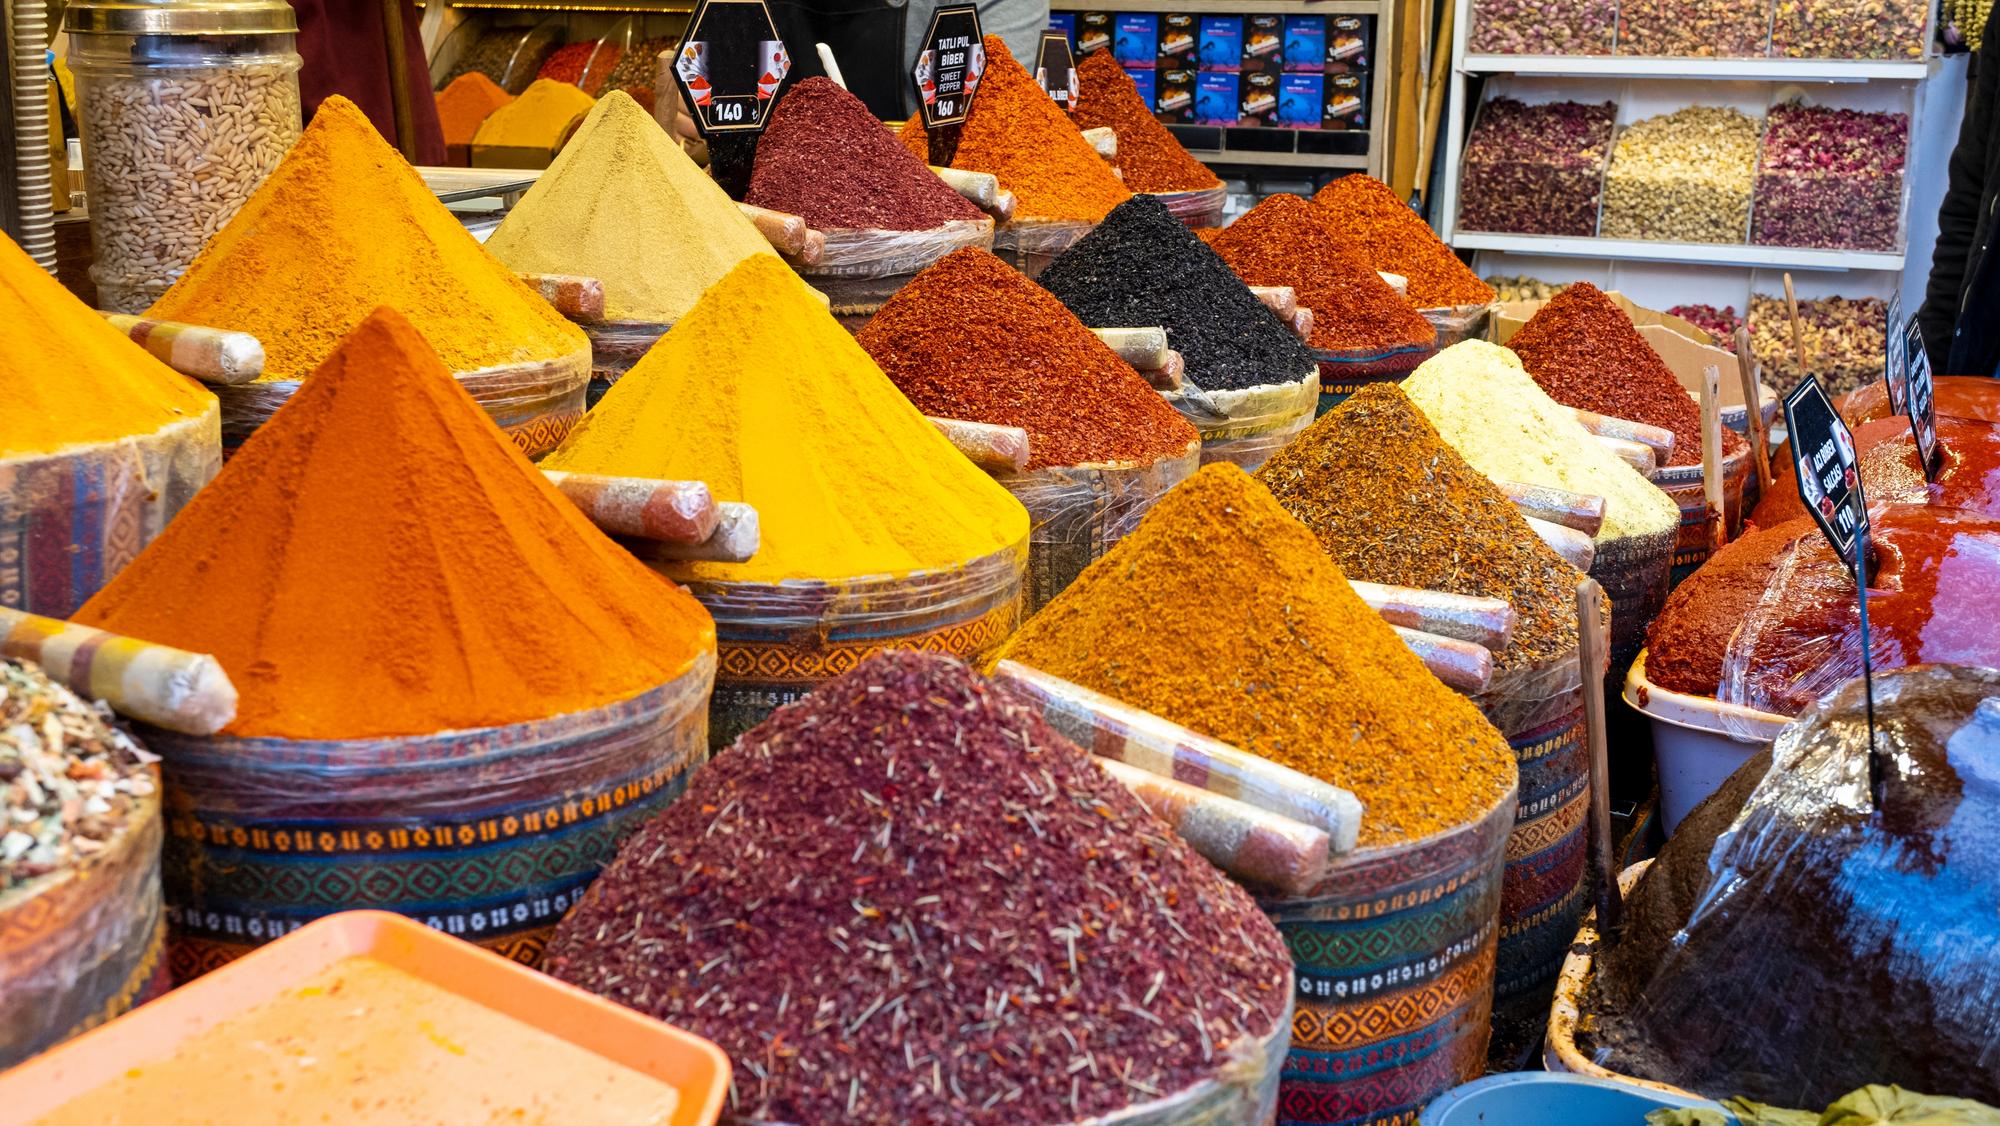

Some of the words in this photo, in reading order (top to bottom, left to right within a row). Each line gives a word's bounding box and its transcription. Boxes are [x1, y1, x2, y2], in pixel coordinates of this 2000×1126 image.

[938, 37, 957, 50] TATLI
[957, 36, 970, 47] PUL
[941, 51, 965, 67] BİBER
[940, 71, 962, 82] SWEET
[938, 81, 961, 92] PEPPER
[715, 103, 742, 121] 140
[937, 100, 954, 117] 160
[1838, 505, 1855, 533] 110
